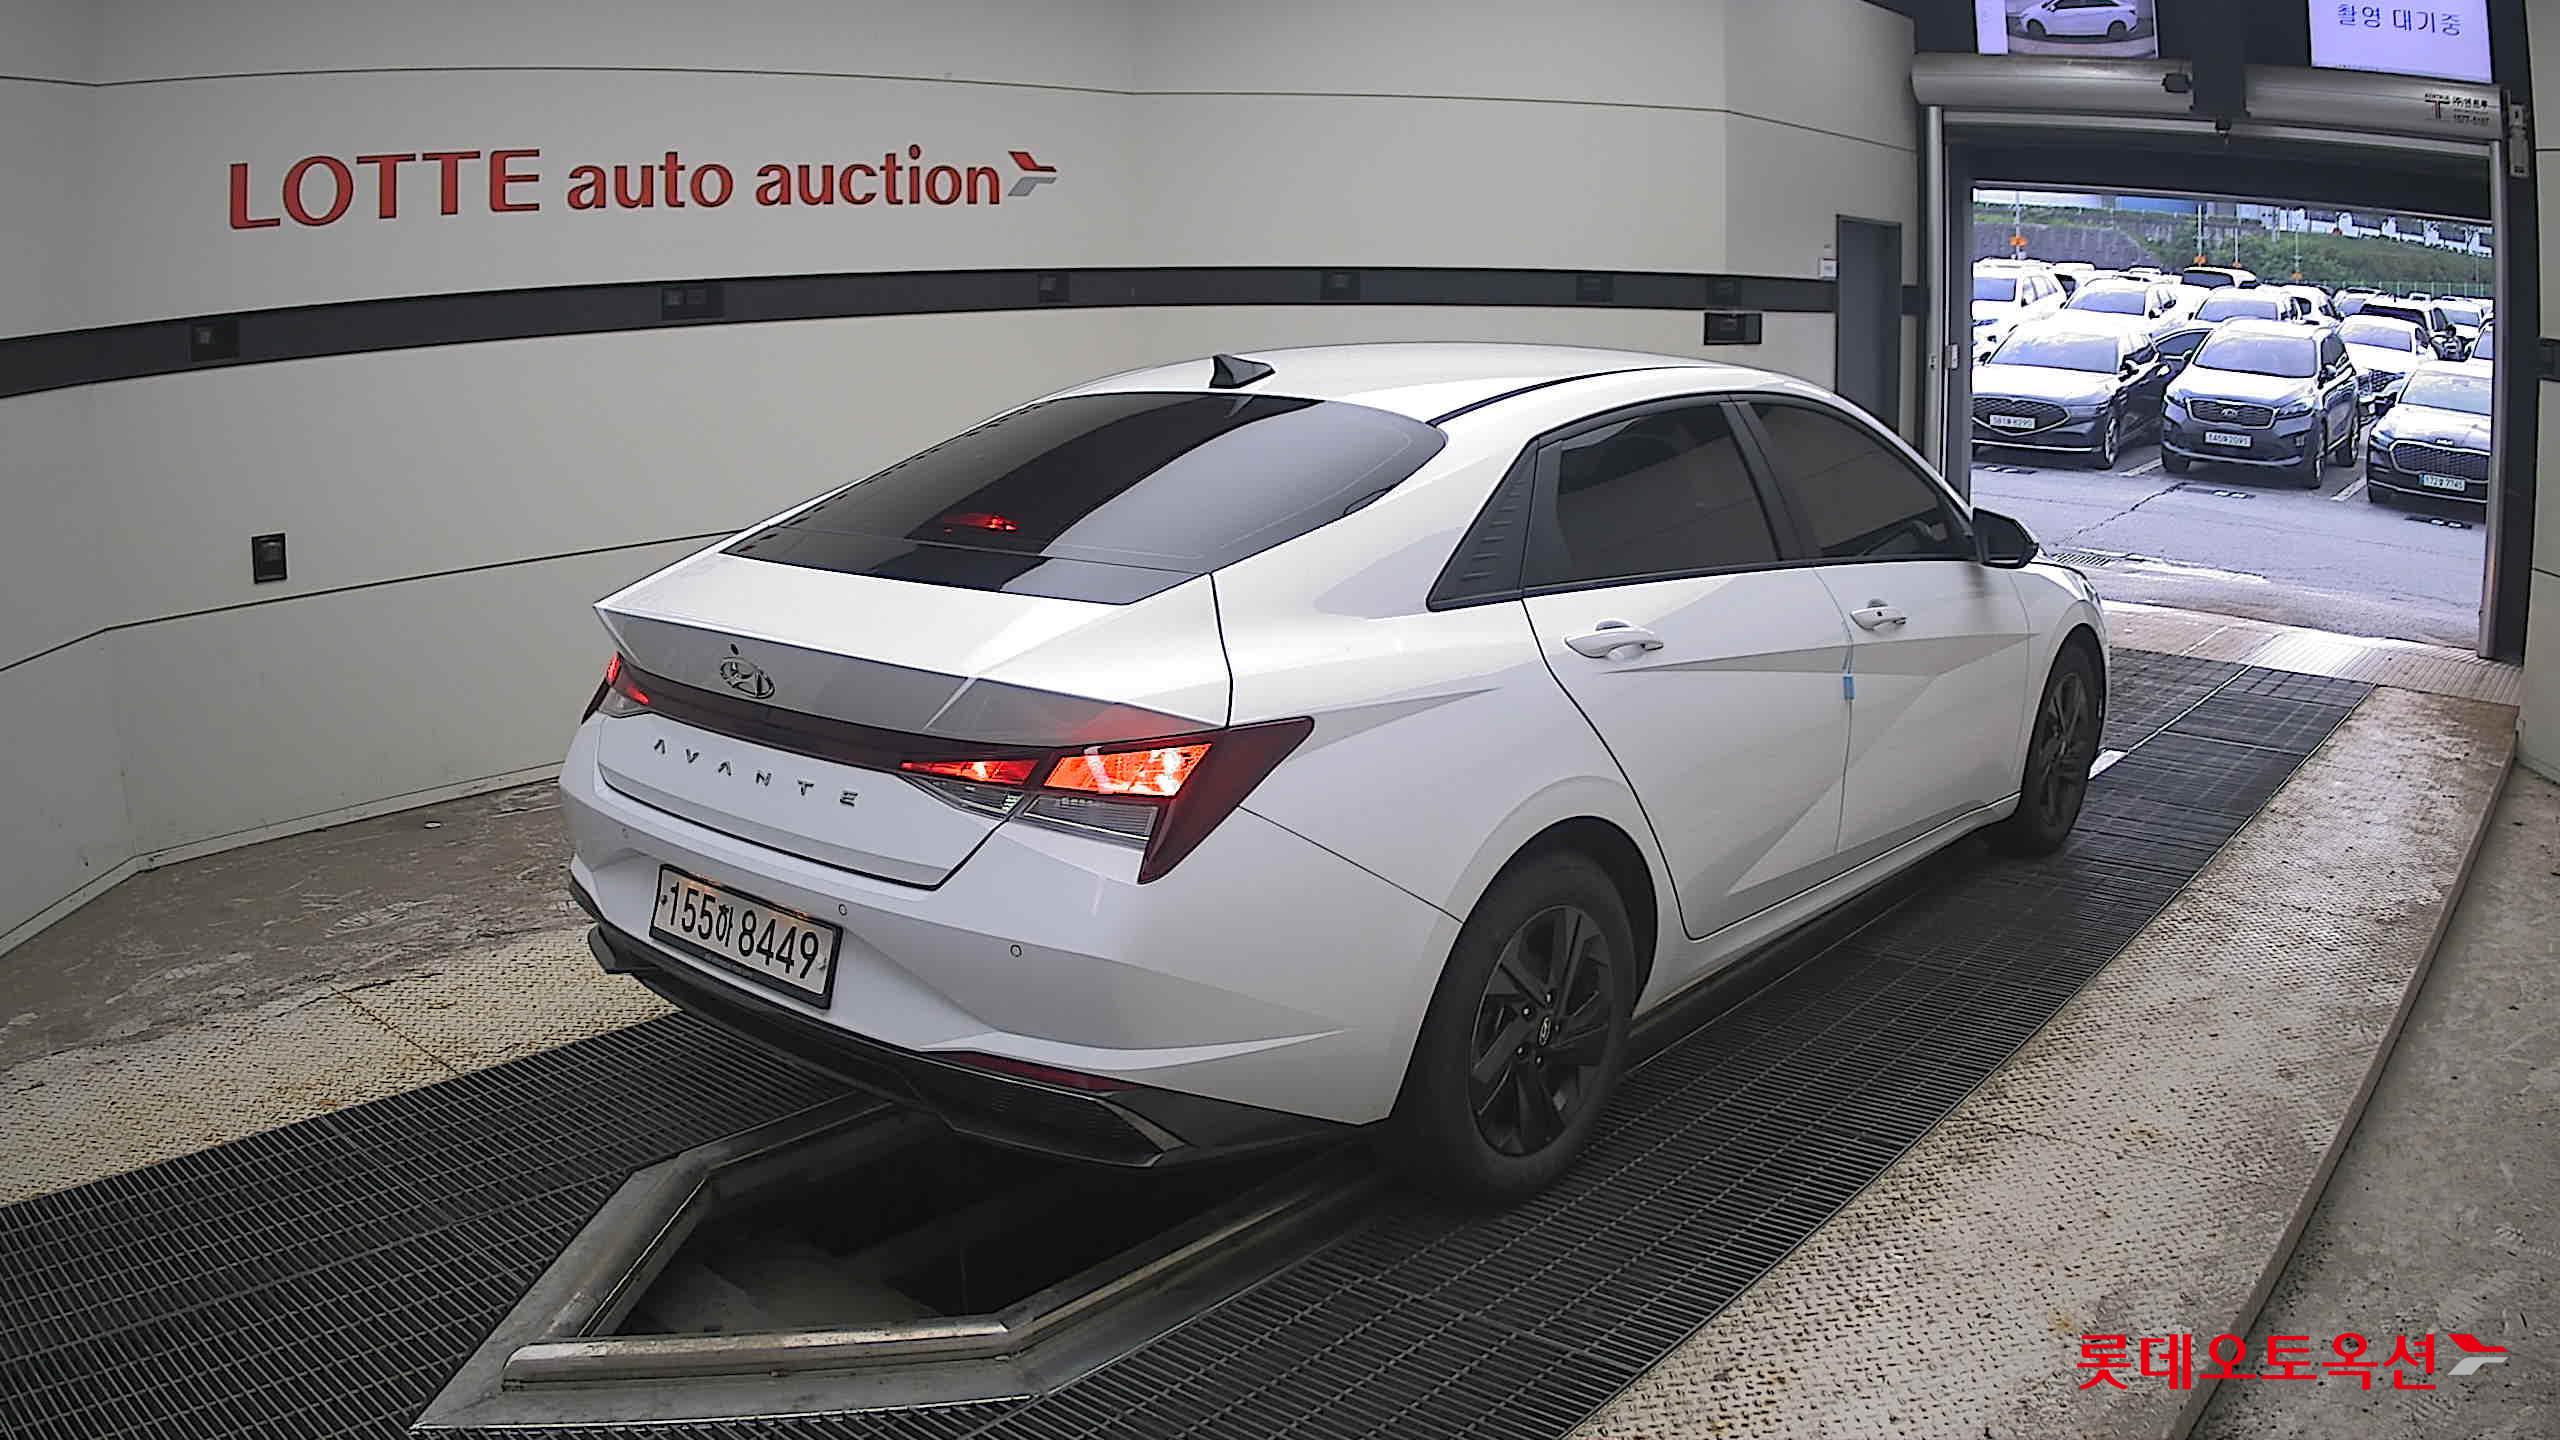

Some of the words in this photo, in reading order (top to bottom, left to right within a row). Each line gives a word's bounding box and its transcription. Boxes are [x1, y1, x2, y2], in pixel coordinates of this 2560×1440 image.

[2392, 9, 2461, 36] 대기중
[229, 149, 540, 230] LOTTE
[567, 150, 733, 210] auto
[755, 145, 1001, 205] auction
[653, 738, 859, 808] AVANTE
[738, 910, 820, 980] 8449
